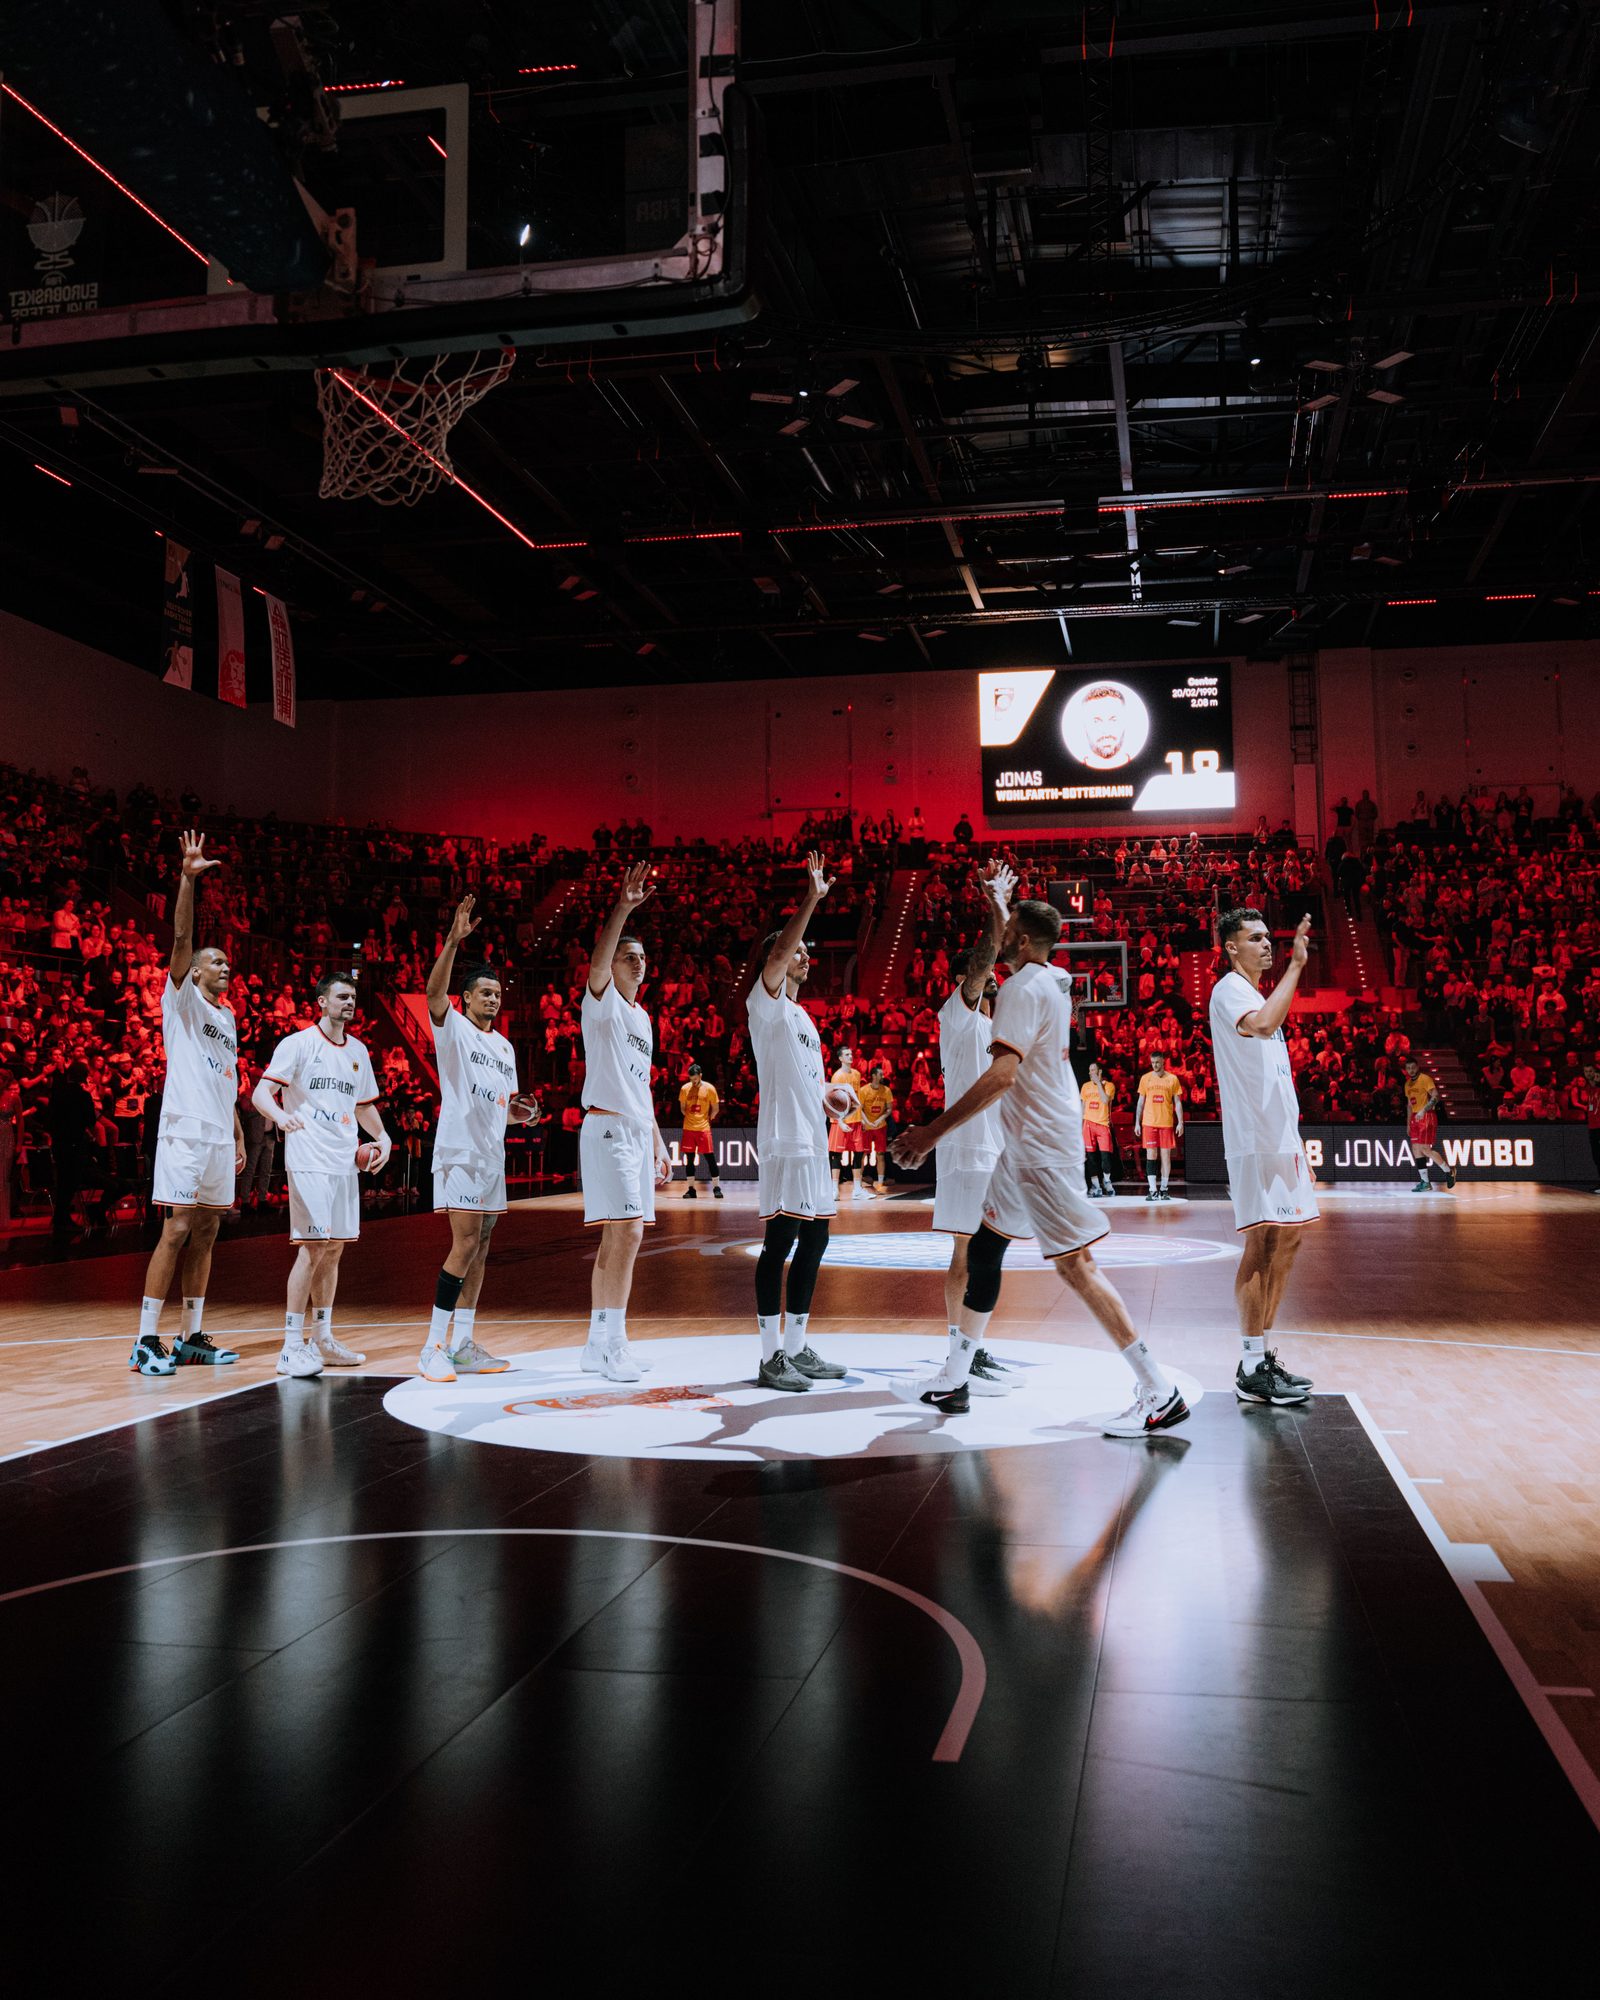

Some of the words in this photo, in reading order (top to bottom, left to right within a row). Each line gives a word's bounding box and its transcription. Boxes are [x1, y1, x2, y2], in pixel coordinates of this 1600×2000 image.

[1172, 687, 1218, 698] 20/02/1990
[1190, 698, 1209, 708] 2.08
[1210, 699, 1218, 707] m
[995, 771, 1043, 788] JONAS
[1070, 895, 1084, 914] 4
[471, 1083, 496, 1102] ING
[716, 1140, 760, 1167] JON
[1305, 1139, 1324, 1167] 8
[1334, 1139, 1433, 1167] JONA
[1442, 1139, 1534, 1167] WOBO
[174, 1190, 194, 1199] ING
[459, 1195, 479, 1205] ING
[1276, 1206, 1294, 1216] ING
